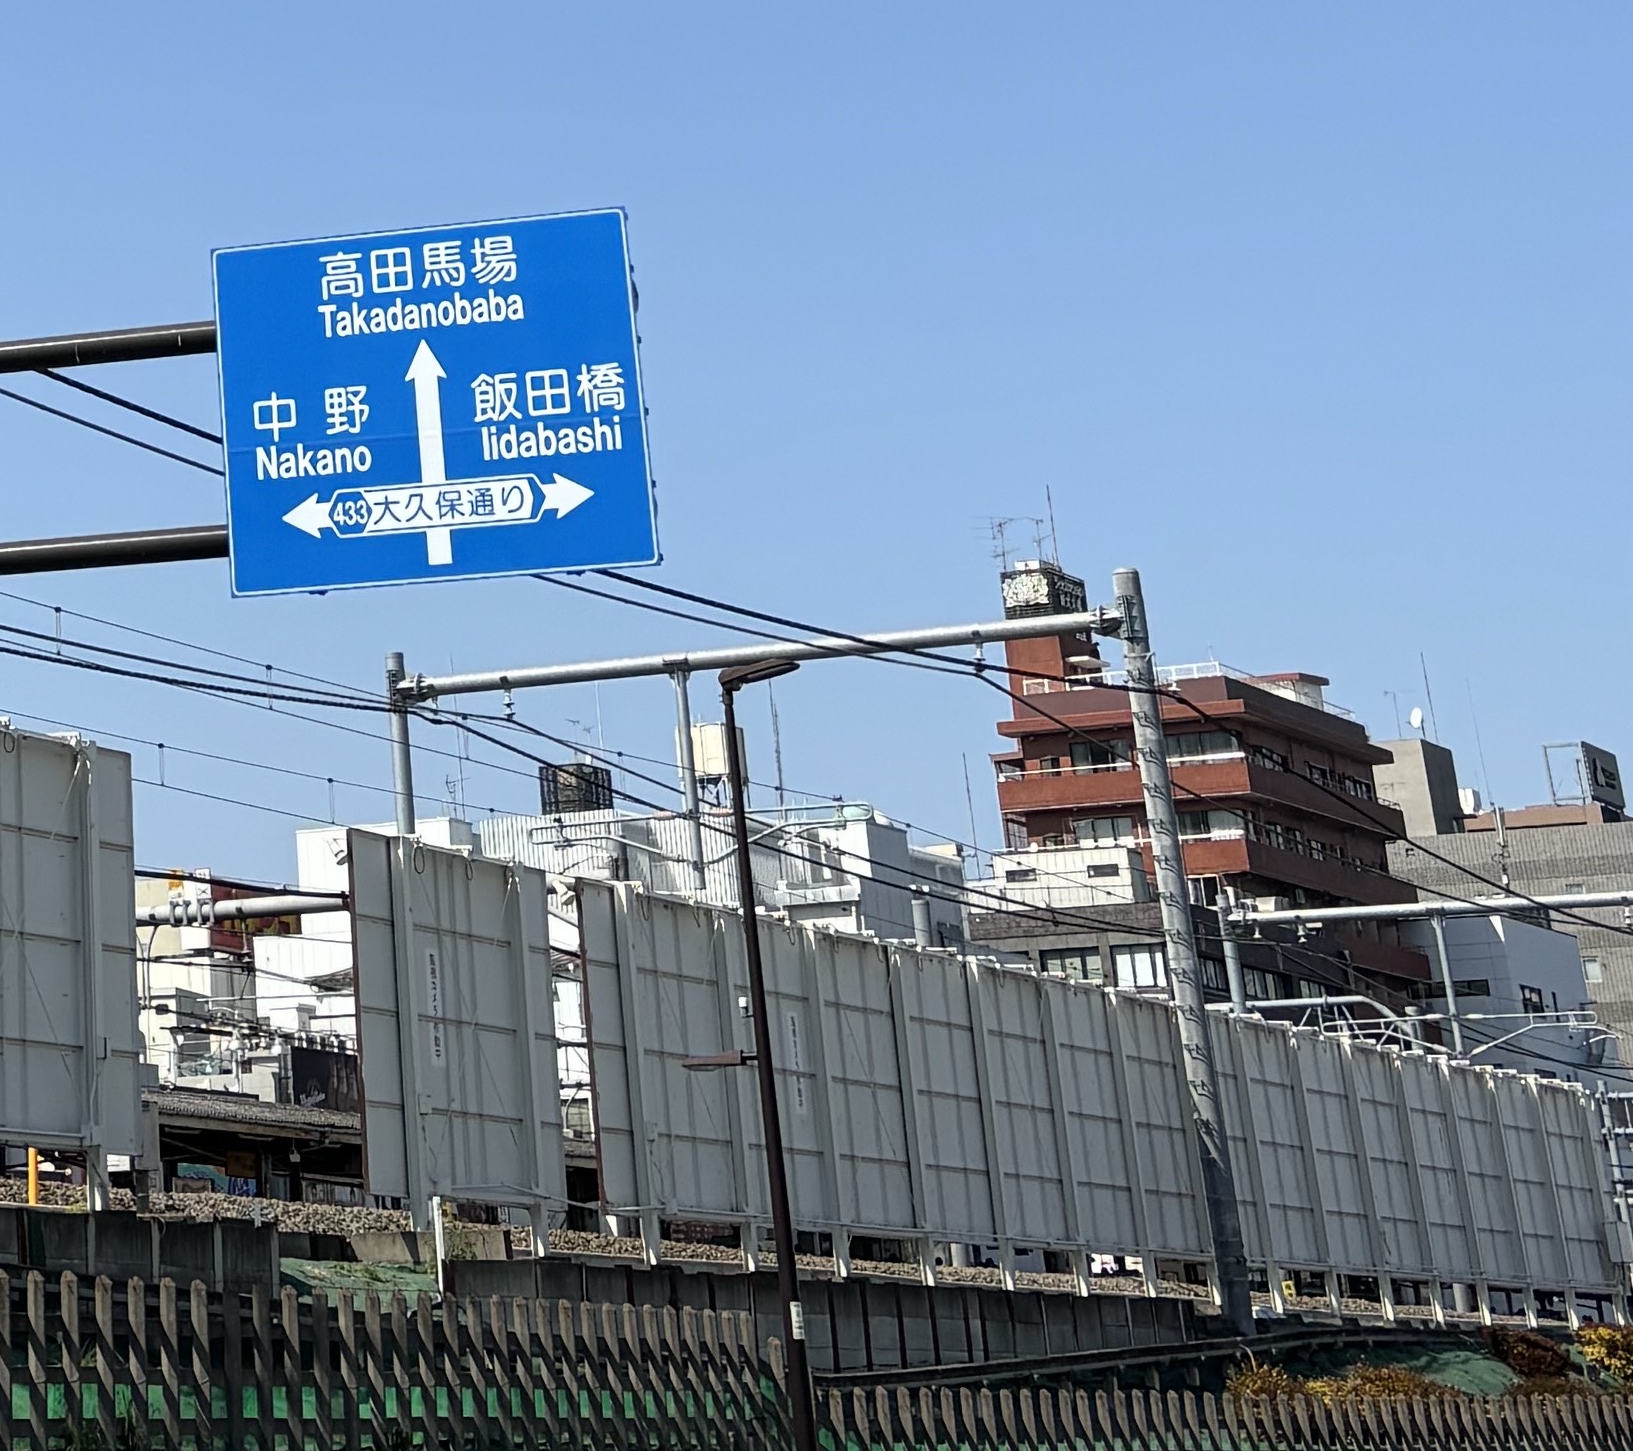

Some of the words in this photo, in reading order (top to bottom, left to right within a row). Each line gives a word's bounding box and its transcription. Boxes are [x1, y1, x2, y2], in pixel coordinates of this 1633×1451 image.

[318, 235, 518, 301] 高田馬場
[317, 288, 525, 338] Takadanobaba
[253, 385, 370, 443] 中野
[470, 362, 626, 423] 飯田橋
[255, 443, 372, 481] Nakano
[481, 415, 622, 461] Iidabashi
[333, 499, 368, 526] 433
[373, 485, 525, 525] 大久保通り
